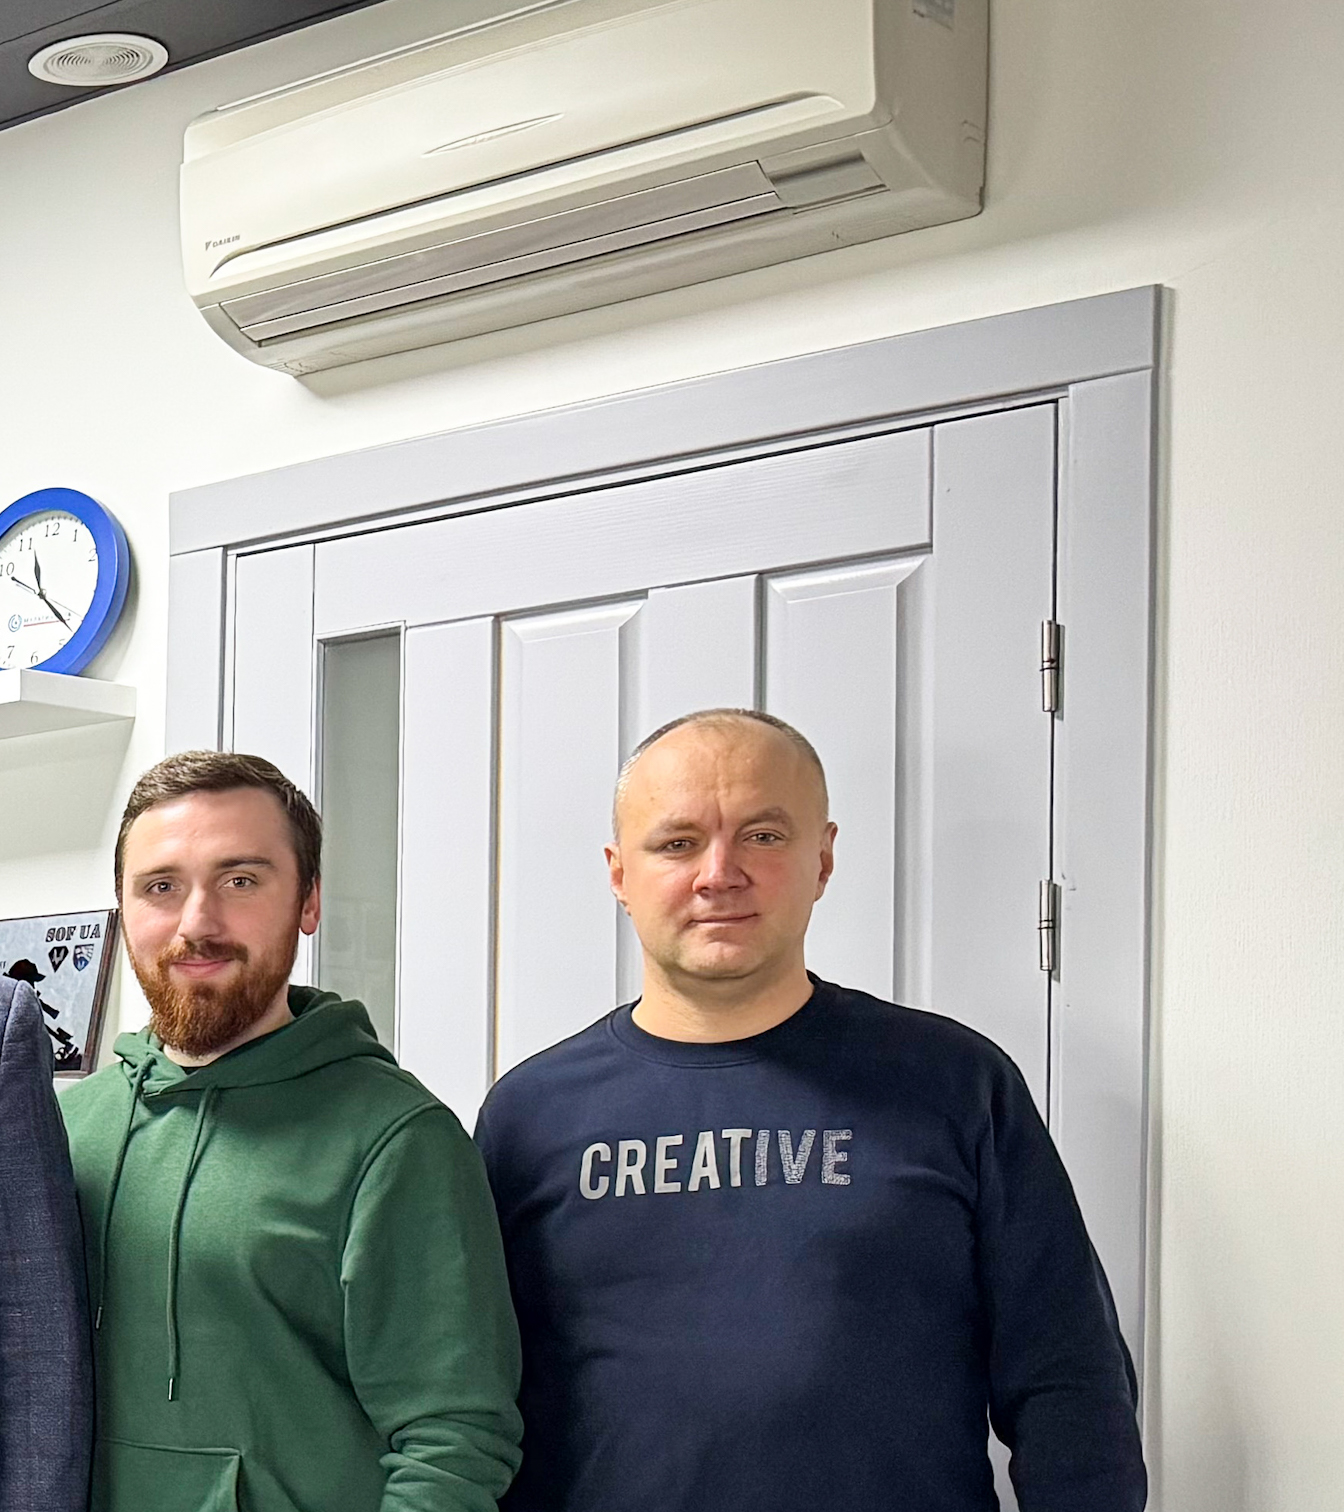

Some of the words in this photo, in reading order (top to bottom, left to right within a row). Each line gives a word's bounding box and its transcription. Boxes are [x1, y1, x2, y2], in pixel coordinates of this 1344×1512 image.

[44, 522, 60, 537] 12
[73, 529, 78, 542] 1
[19, 537, 33, 551] 11
[7, 645, 15, 659] 7
[30, 651, 38, 665] 6
[45, 926, 76, 942] SOF
[80, 924, 100, 939] UA
[579, 1128, 853, 1200] CREATIVE
